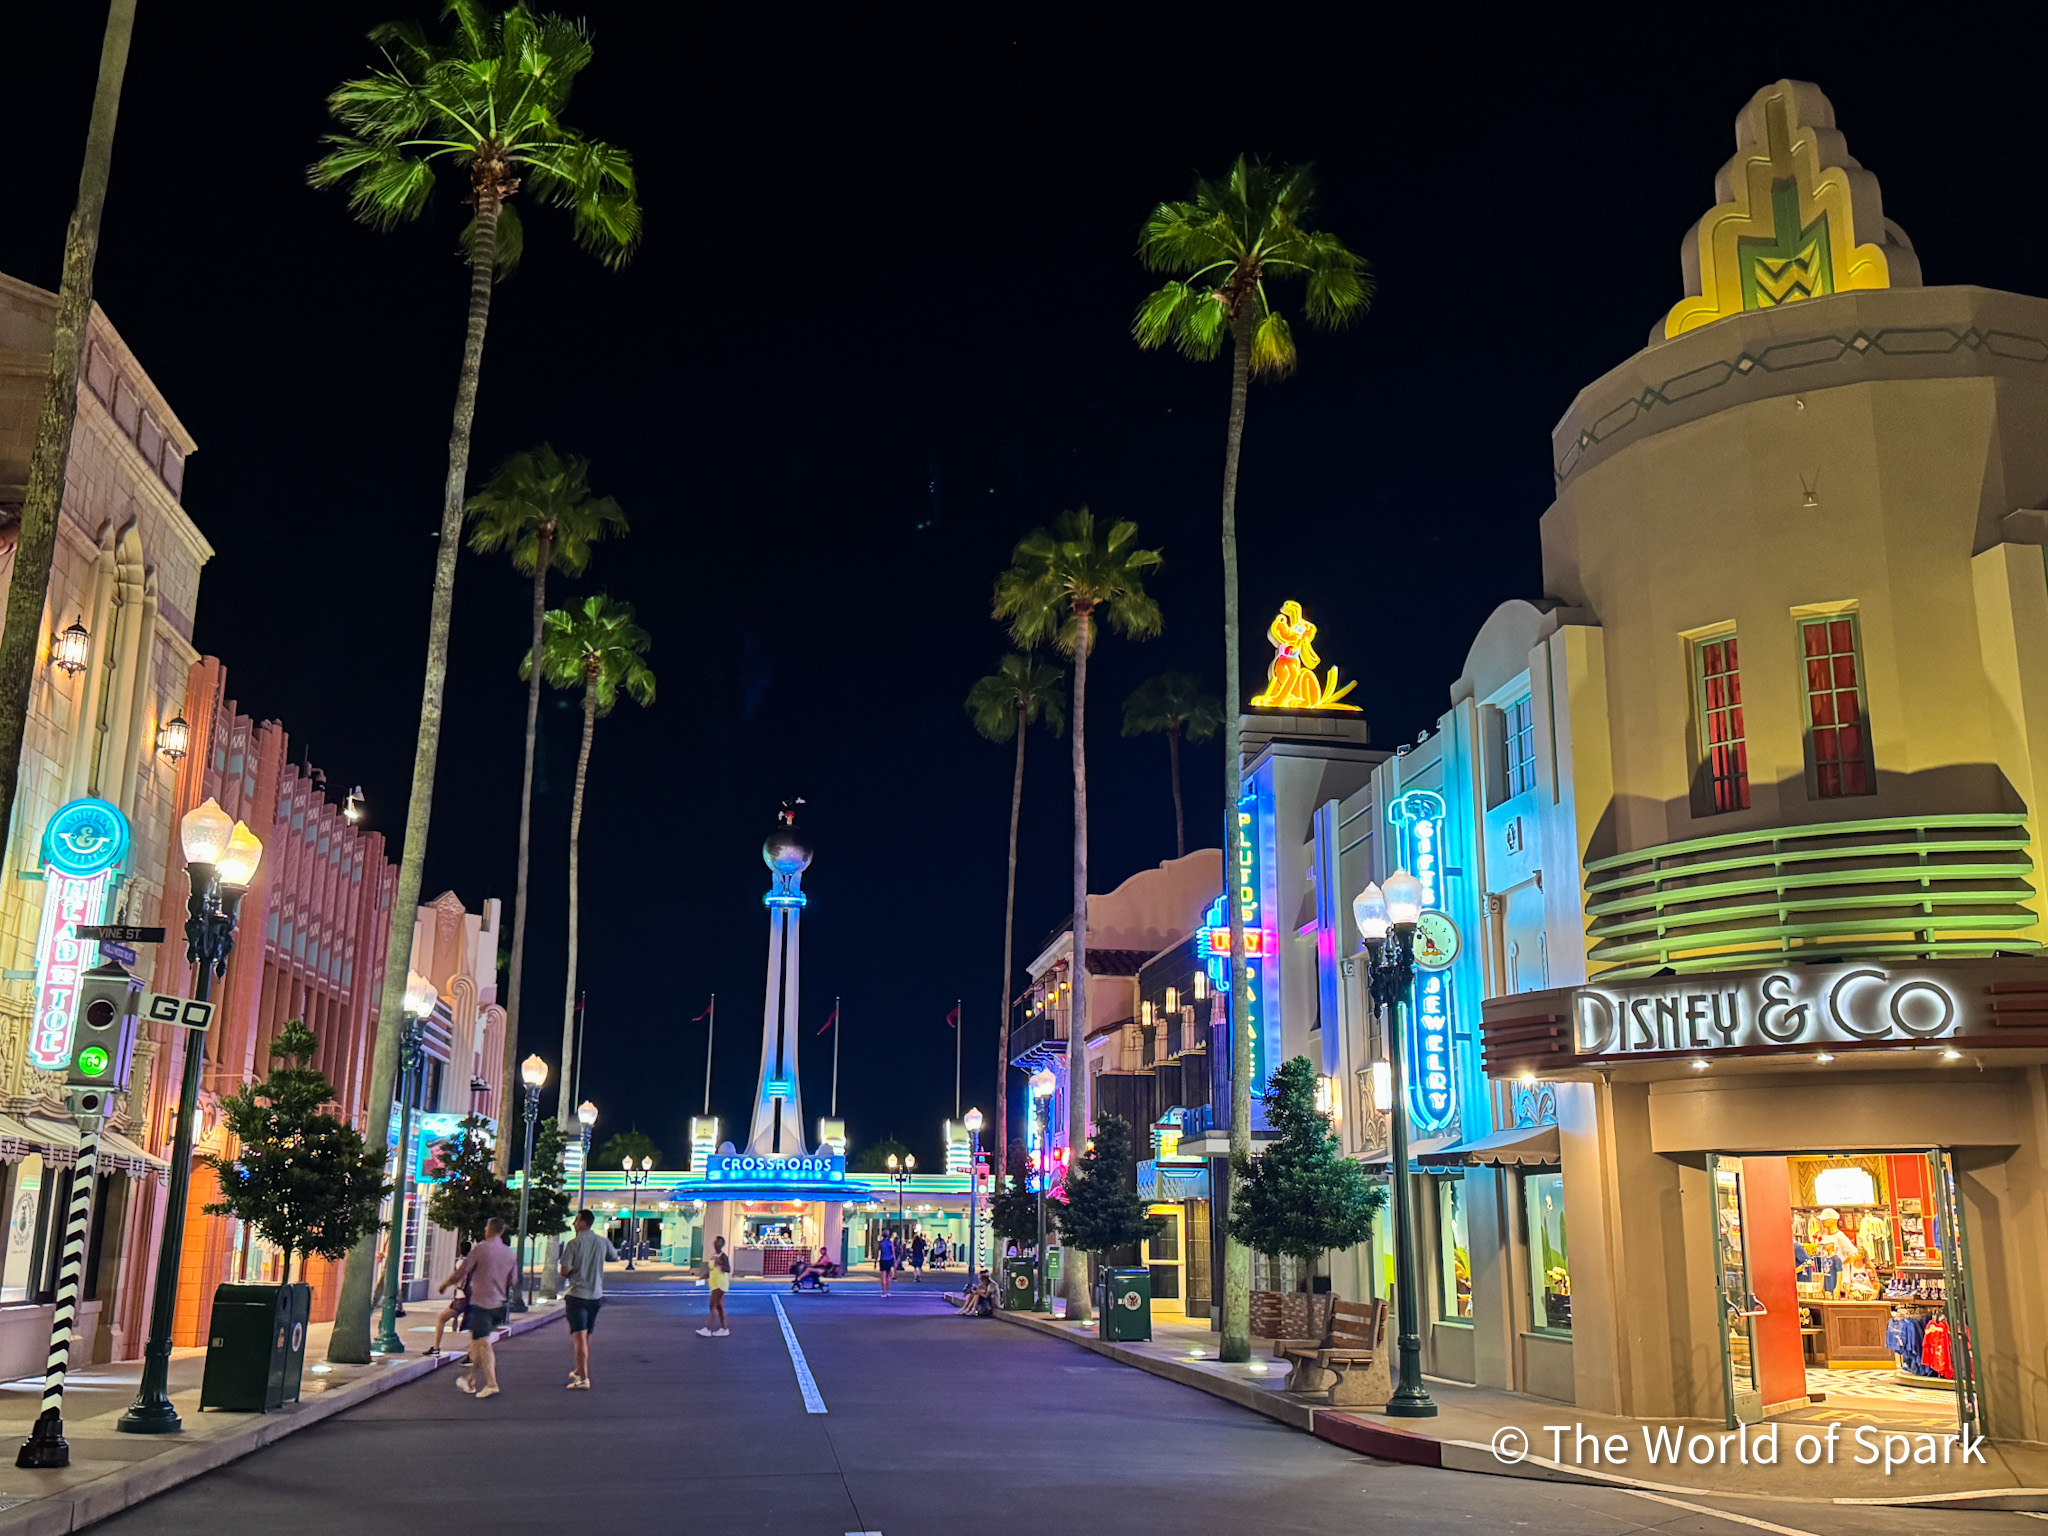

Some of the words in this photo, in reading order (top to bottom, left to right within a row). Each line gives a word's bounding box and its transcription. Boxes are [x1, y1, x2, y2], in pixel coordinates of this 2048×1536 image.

[76, 827, 95, 847] &
[1415, 820, 1436, 905] GIFTS
[99, 927, 122, 938] VINE
[125, 928, 142, 940] ST.
[150, 995, 211, 1028] GO
[1572, 990, 1740, 1055] DISNEY
[1757, 975, 1810, 1043] &
[1421, 976, 1448, 1110] JEWELRY
[85, 1056, 102, 1068] GO
[721, 1157, 832, 1171] CROSSROADS
